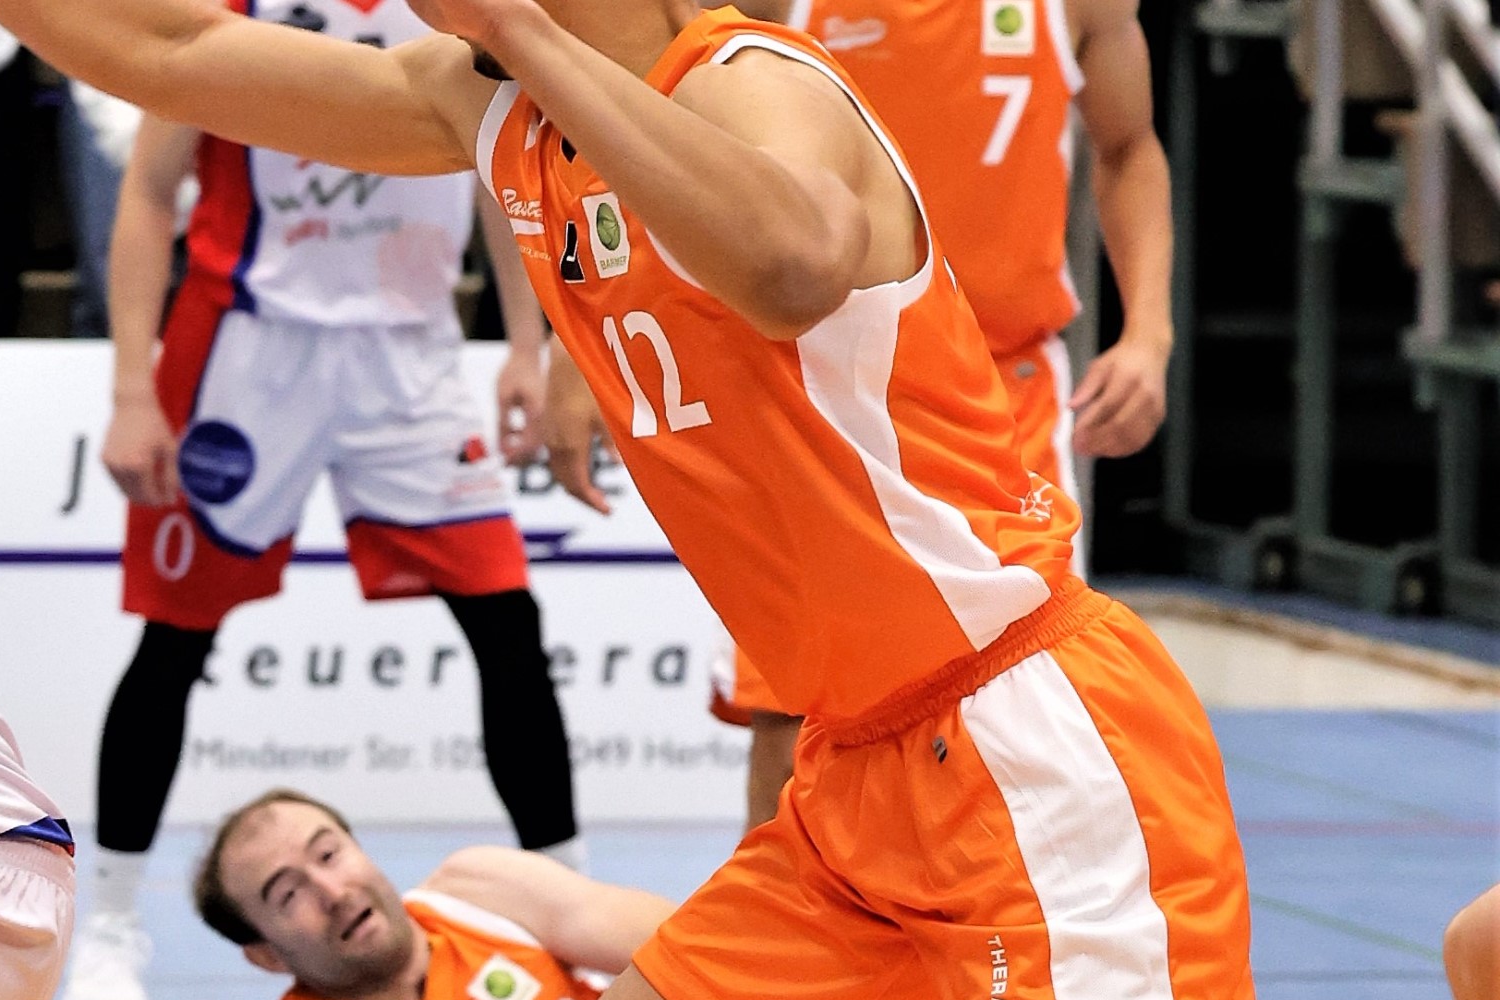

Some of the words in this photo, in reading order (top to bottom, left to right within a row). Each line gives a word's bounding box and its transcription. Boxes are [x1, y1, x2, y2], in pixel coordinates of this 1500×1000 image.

[981, 74, 1032, 166] 7
[603, 310, 713, 438] 12
[153, 511, 196, 582] 0
